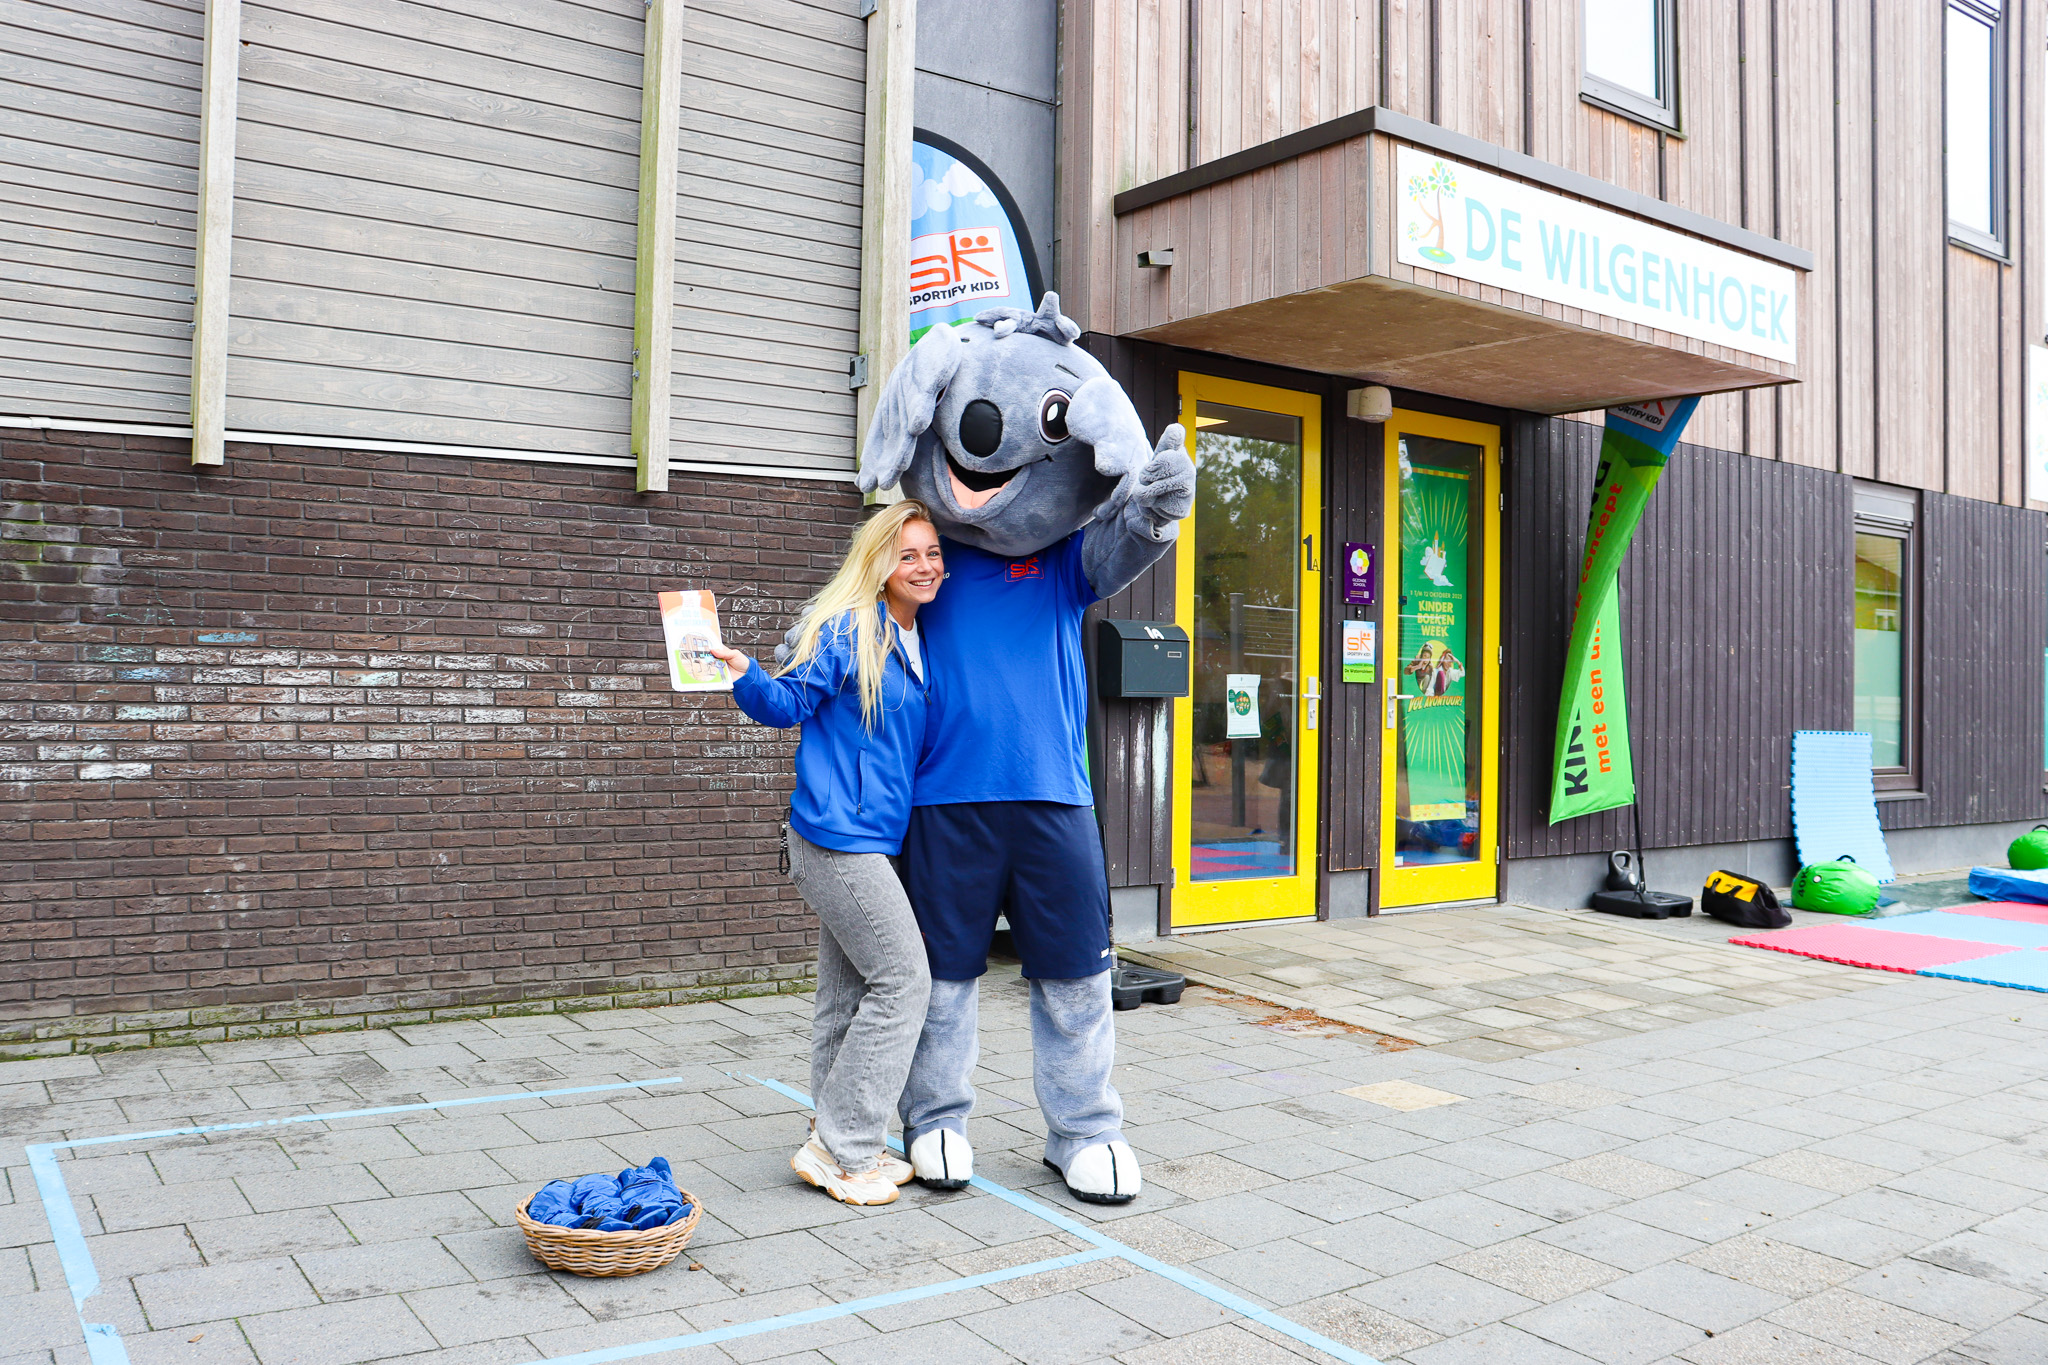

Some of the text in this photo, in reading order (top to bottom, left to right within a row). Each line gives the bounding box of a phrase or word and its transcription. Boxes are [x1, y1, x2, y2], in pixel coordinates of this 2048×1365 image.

[1465, 196, 1789, 344] DE WILGENHOEK
[970, 280, 1000, 292] KIDS
[1645, 414, 1663, 426] KIDS
[1582, 482, 1623, 583] concept
[1418, 600, 1454, 613] KINDER
[1417, 613, 1455, 625] BOEKEN
[1421, 625, 1449, 637] WEEK
[1590, 669, 1605, 715] een
[1407, 695, 1464, 713] VOL AVONTUUR!
[1592, 722, 1612, 773] met
